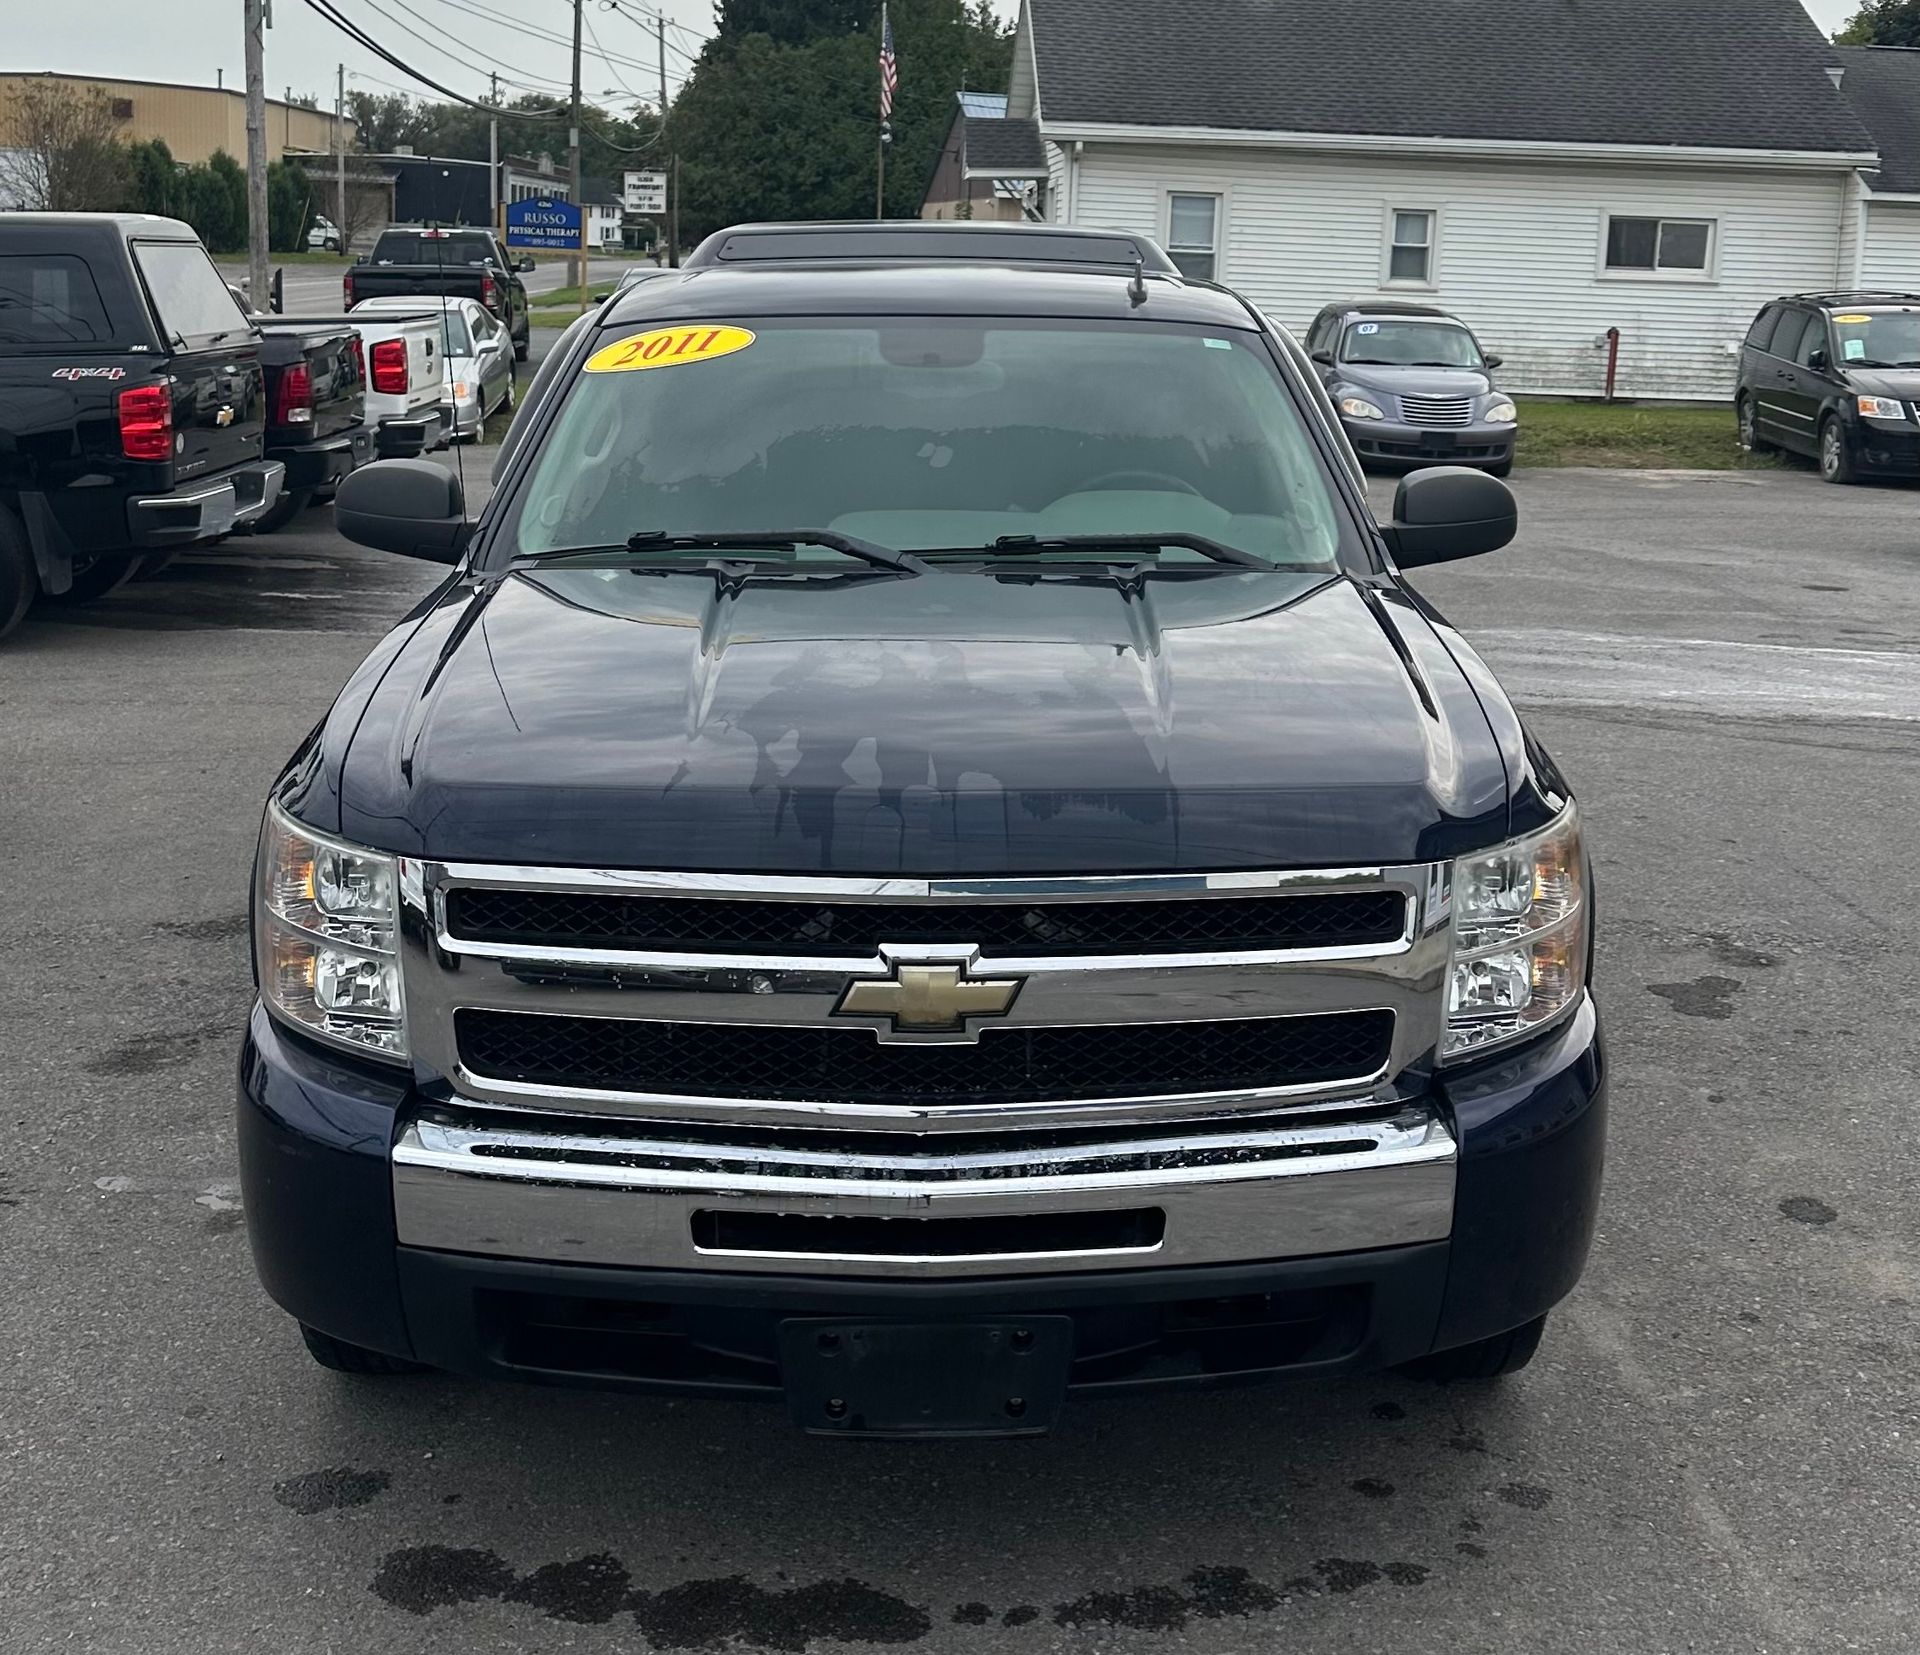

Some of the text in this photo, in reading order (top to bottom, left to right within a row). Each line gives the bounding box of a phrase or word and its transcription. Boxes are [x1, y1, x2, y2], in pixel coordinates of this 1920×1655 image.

[524, 212, 567, 225] RUSSO
[509, 226, 580, 237] PHYSICAL THERAPY
[611, 329, 723, 367] 2011
